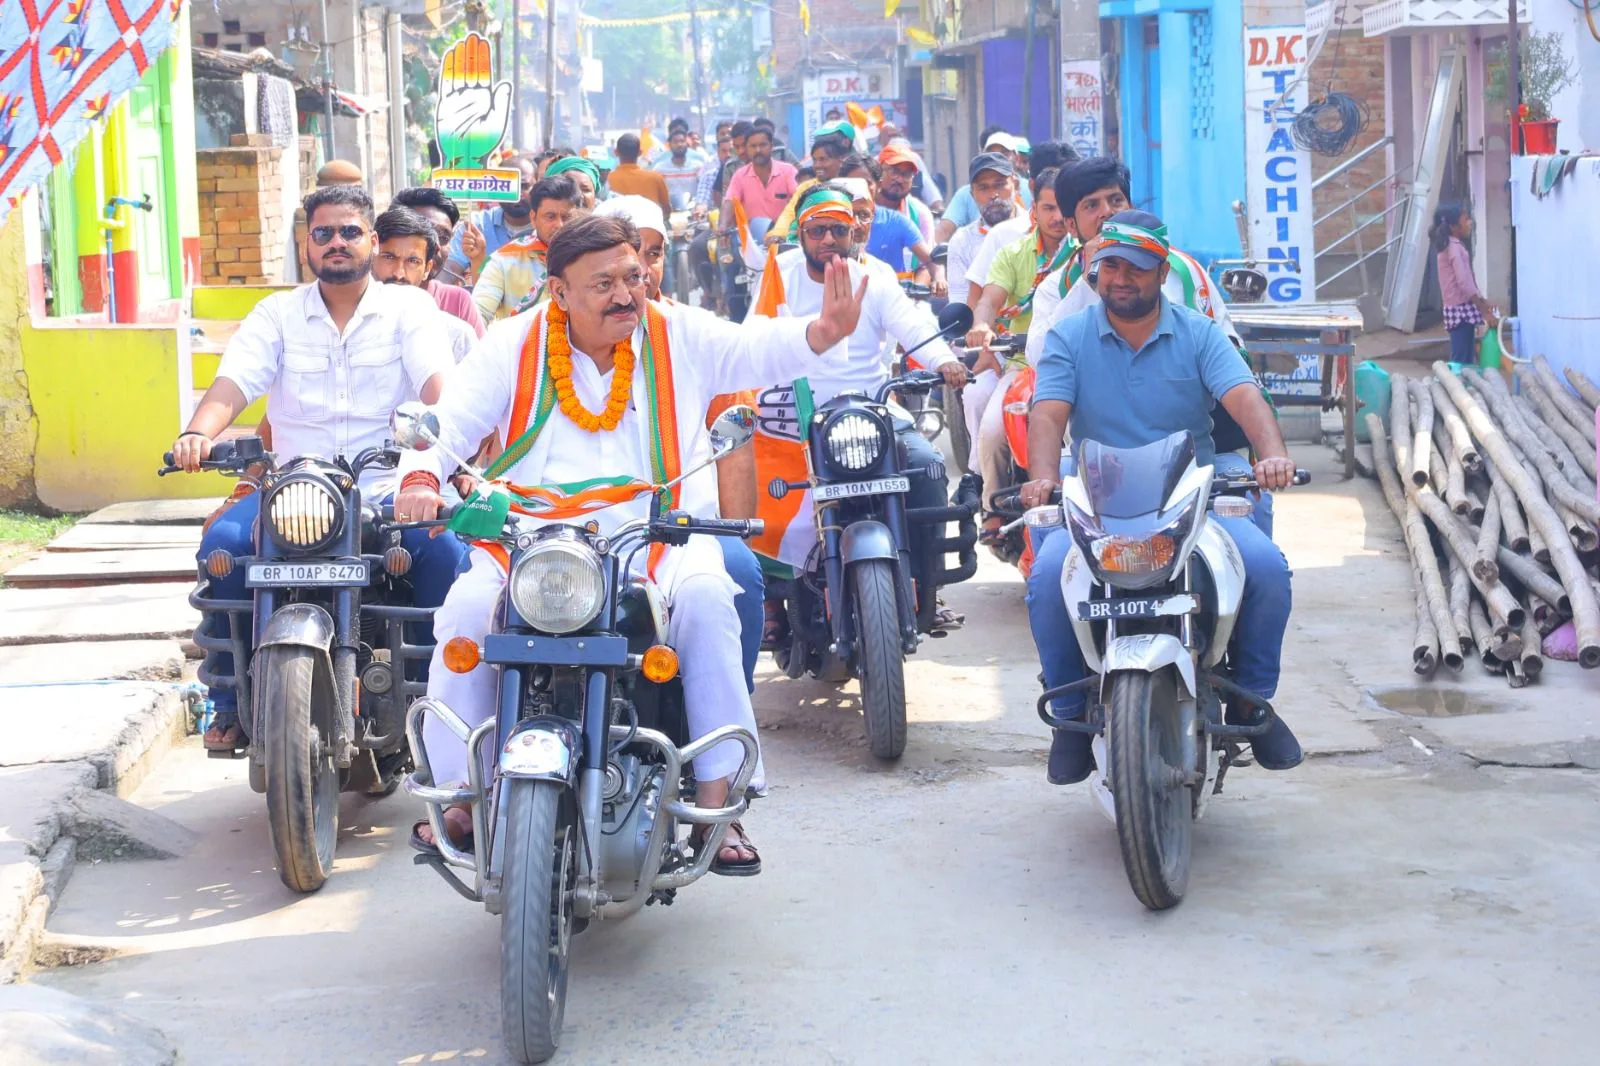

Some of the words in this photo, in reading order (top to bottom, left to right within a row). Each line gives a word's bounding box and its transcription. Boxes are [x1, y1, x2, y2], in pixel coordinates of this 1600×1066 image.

[1248, 34, 1306, 67] D.K.
[446, 178, 465, 190] घर
[467, 176, 511, 192] कांग्रेस
[1262, 69, 1302, 303] TEACHING
[825, 487, 841, 497] BR
[846, 482, 873, 494] 10AV
[879, 480, 907, 491] 1658
[263, 567, 281, 580] BR
[290, 567, 322, 579] 10AP
[329, 566, 364, 579] 6470
[1090, 603, 1112, 617] BR
